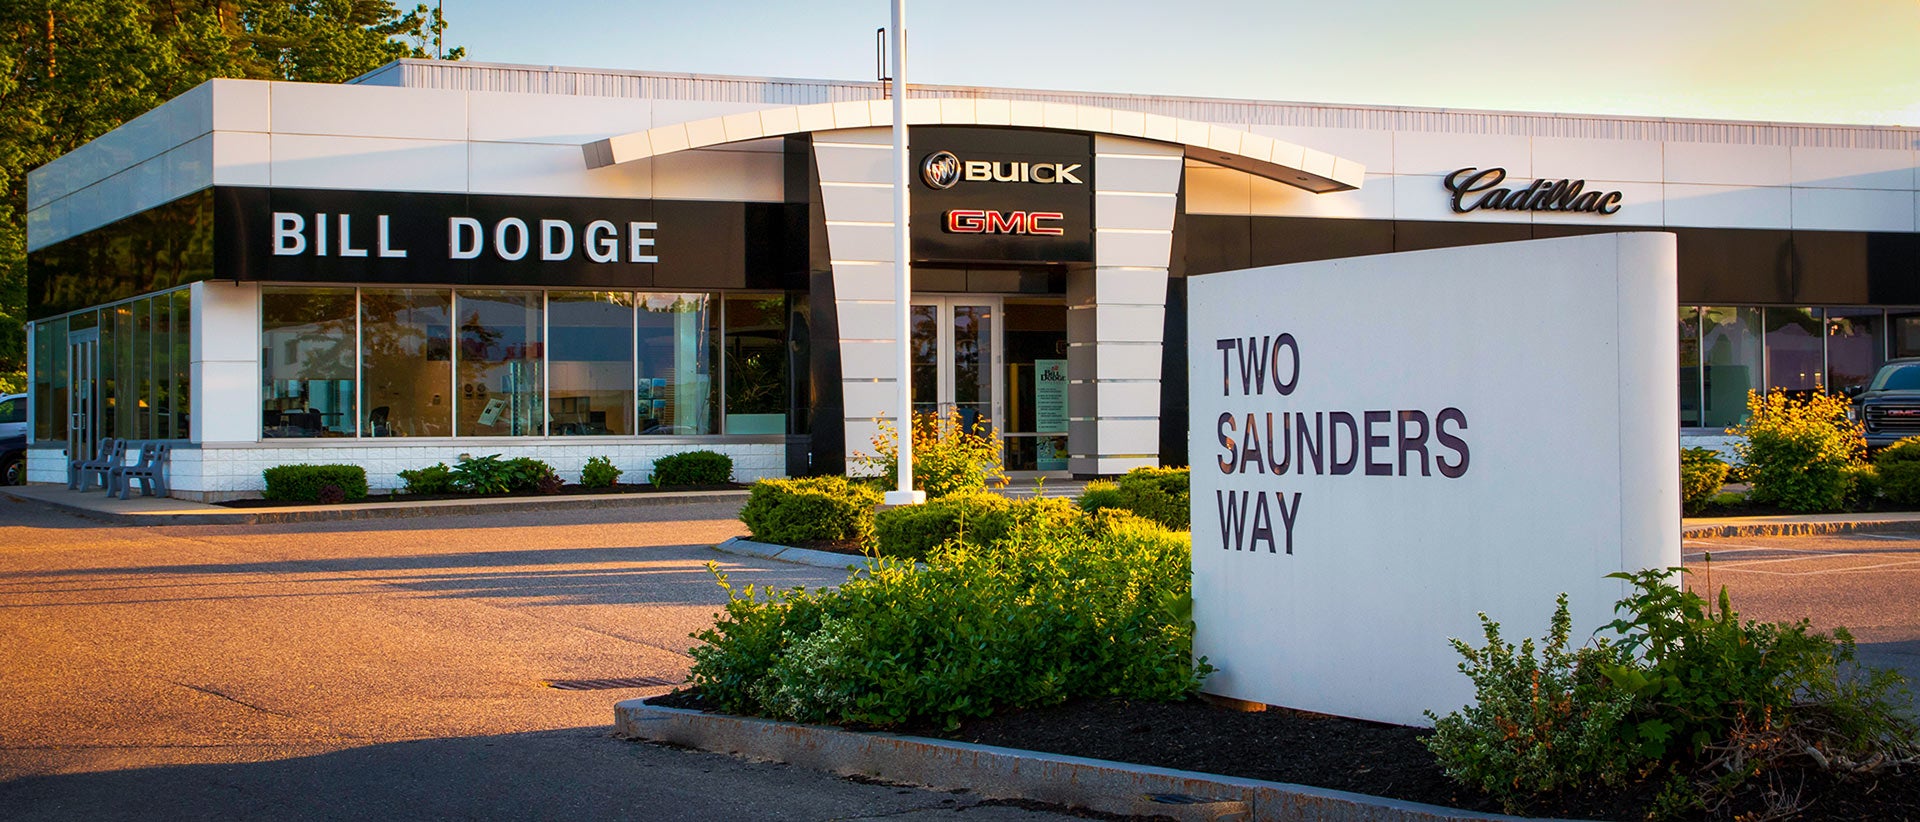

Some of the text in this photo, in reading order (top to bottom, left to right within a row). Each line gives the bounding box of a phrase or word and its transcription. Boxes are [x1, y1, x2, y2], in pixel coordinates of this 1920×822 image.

[965, 160, 1083, 184] BUICK
[1444, 167, 1623, 215] Cadillac
[272, 211, 659, 263] BILL DODGE
[947, 209, 1064, 236] GMC
[1216, 332, 1300, 397] TWO
[1217, 407, 1471, 479] SAUNDERS
[1216, 489, 1302, 556] WAY
